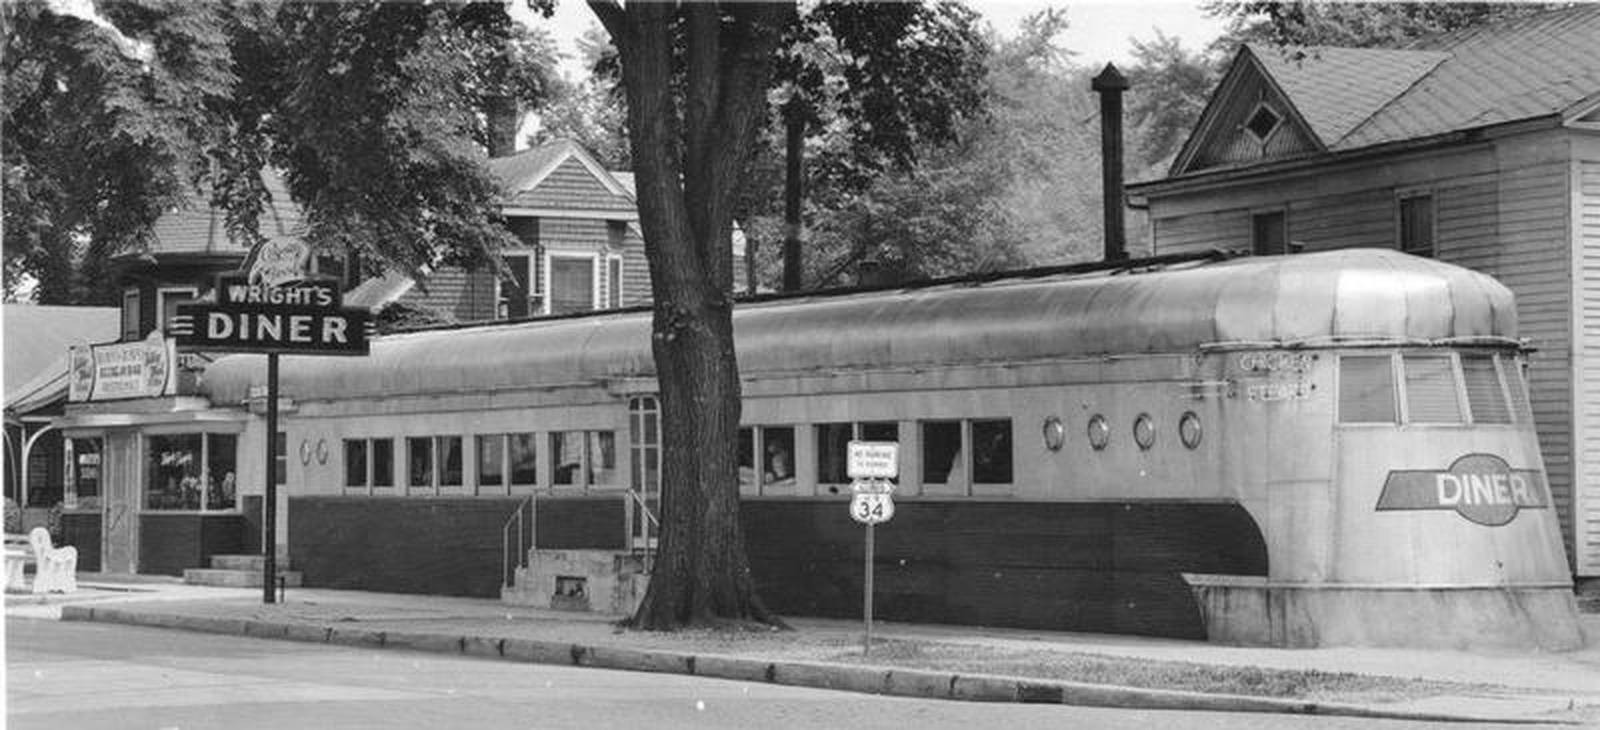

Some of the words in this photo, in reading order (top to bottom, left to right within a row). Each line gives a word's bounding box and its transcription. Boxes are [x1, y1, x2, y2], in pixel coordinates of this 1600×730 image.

[228, 284, 332, 306] WRIGHT'S
[207, 312, 347, 343] DINER
[1436, 473, 1535, 505] DINER
[859, 501, 883, 518] 34
